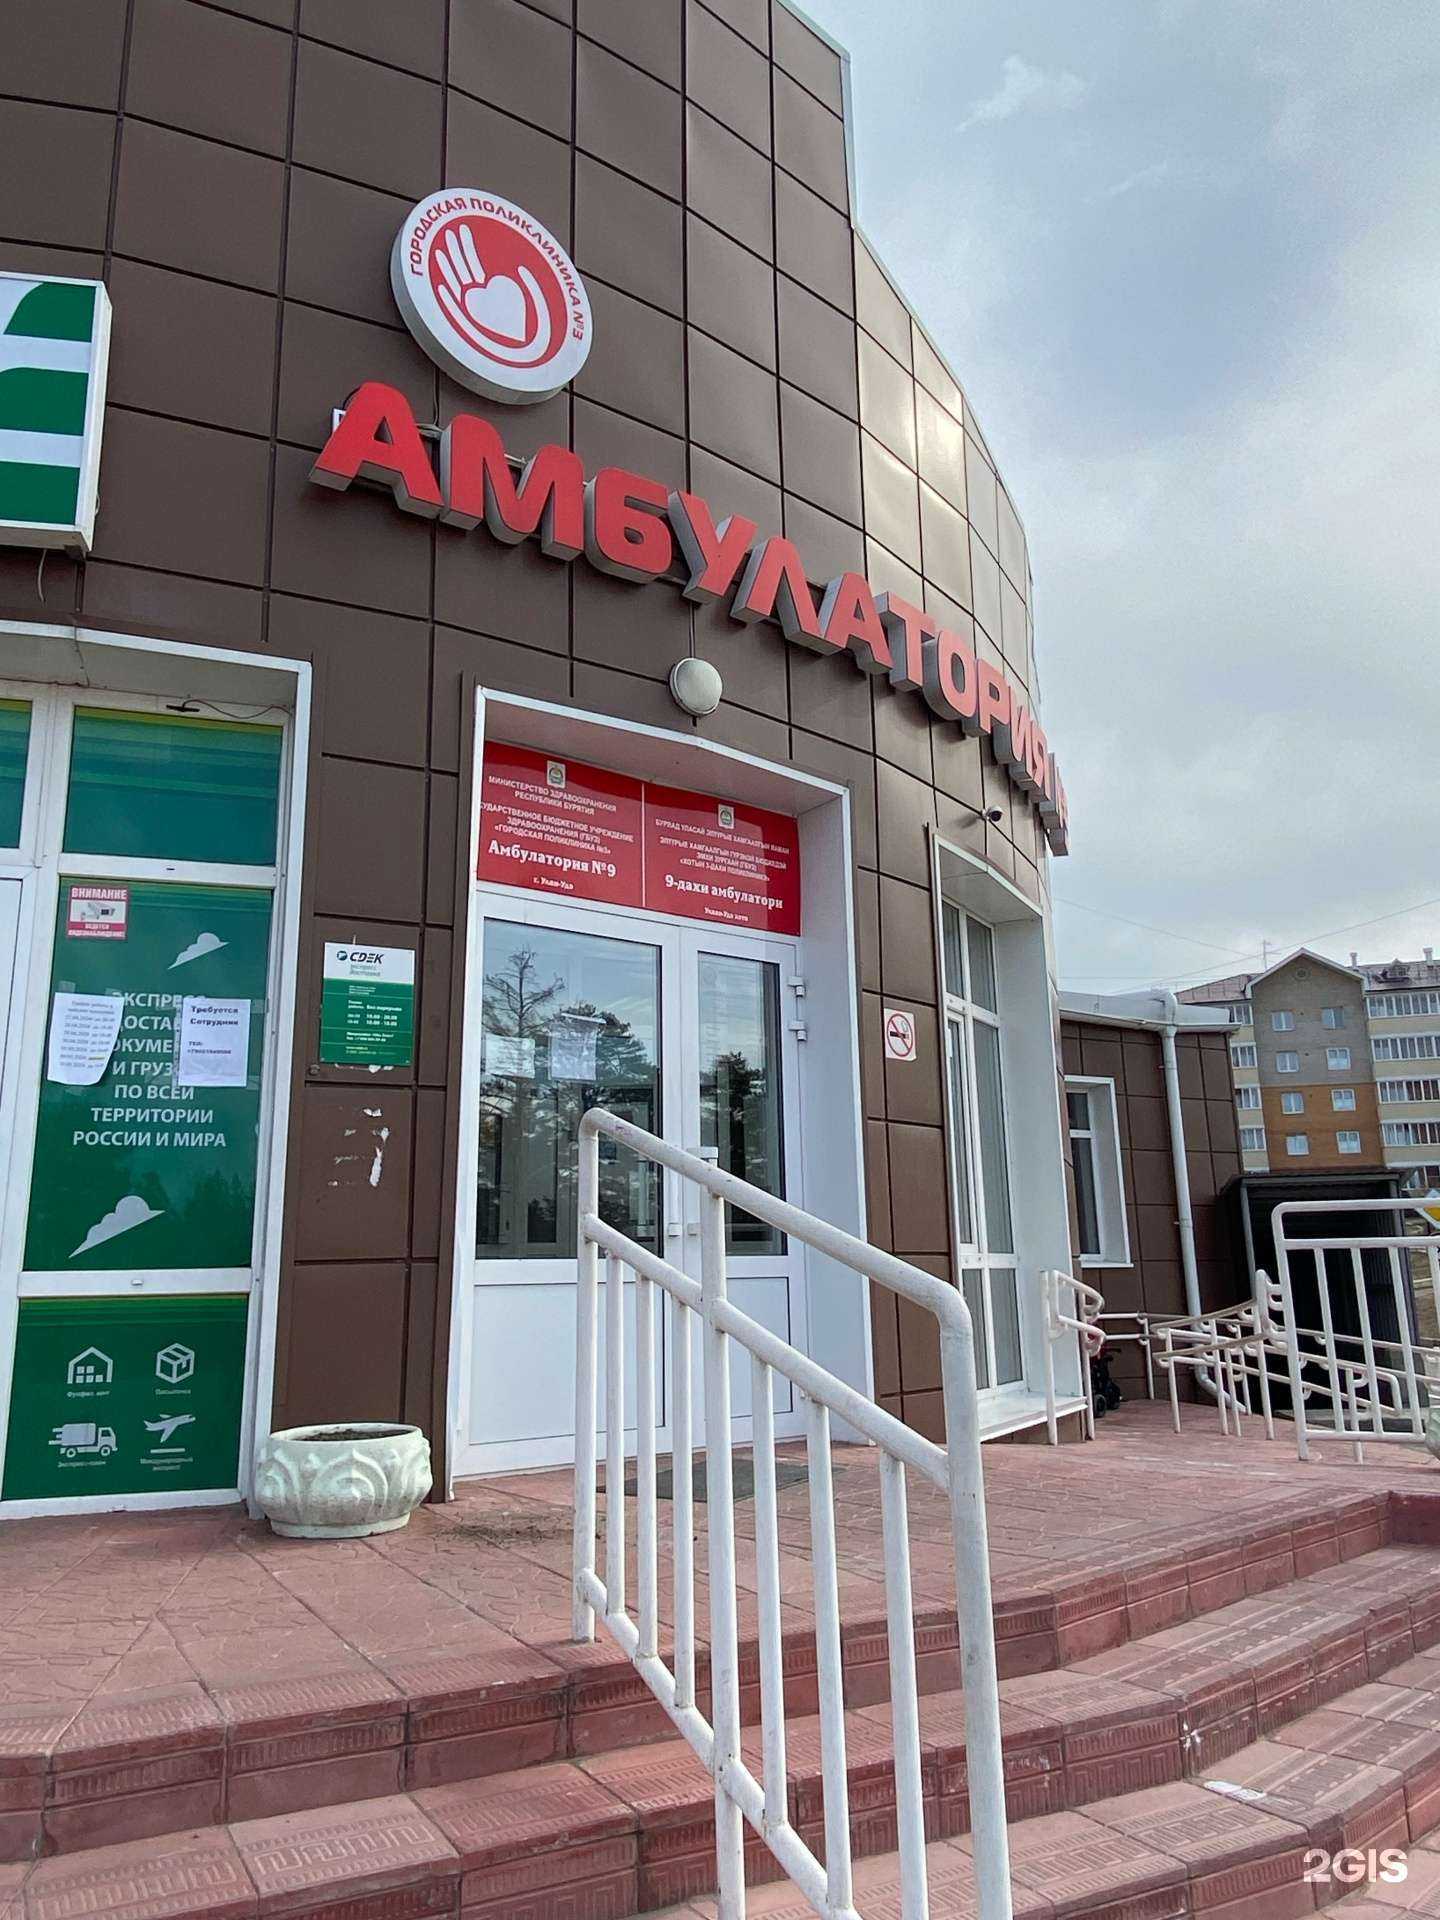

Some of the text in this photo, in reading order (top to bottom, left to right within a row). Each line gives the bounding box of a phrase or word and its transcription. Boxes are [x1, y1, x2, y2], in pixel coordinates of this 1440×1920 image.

[409, 197, 468, 277] ГОРОДСКАЯ
[470, 197, 581, 308] ПОЛИКЛИНИКА
[309, 381, 1054, 808] АМБУЛАТОРИЯ
[488, 775, 617, 813] МИНИСТЕРСТВО ЗДРАВООХРАНЕНИЯ
[514, 790, 595, 816] РЕСПУБЛИКИ БУРЯТИЯ
[507, 816, 579, 840] ЗДРАВООХРАНЕНИЯ
[543, 813, 588, 832] БЮДЖЕТНОЕ
[589, 825, 634, 843] УЧРЕЖДЕНИЕ
[544, 834, 595, 851] ПОЛИКЛИНИКА
[488, 839, 617, 878] Амбулатория №9
[540, 876, 574, 891] Улан-Удэ
[664, 874, 784, 911] 9-дахи амбулатори
[71, 887, 128, 900] ВНИМАНИЕ
[350, 952, 385, 965] CDEK
[191, 1005, 239, 1014] Требуется
[112, 1061, 126, 1076] И
[114, 1084, 143, 1099] ПО
[90, 1107, 214, 1124] ТЕРРИТОРИИ
[73, 1130, 227, 1148] РОССИИ И МИРА
